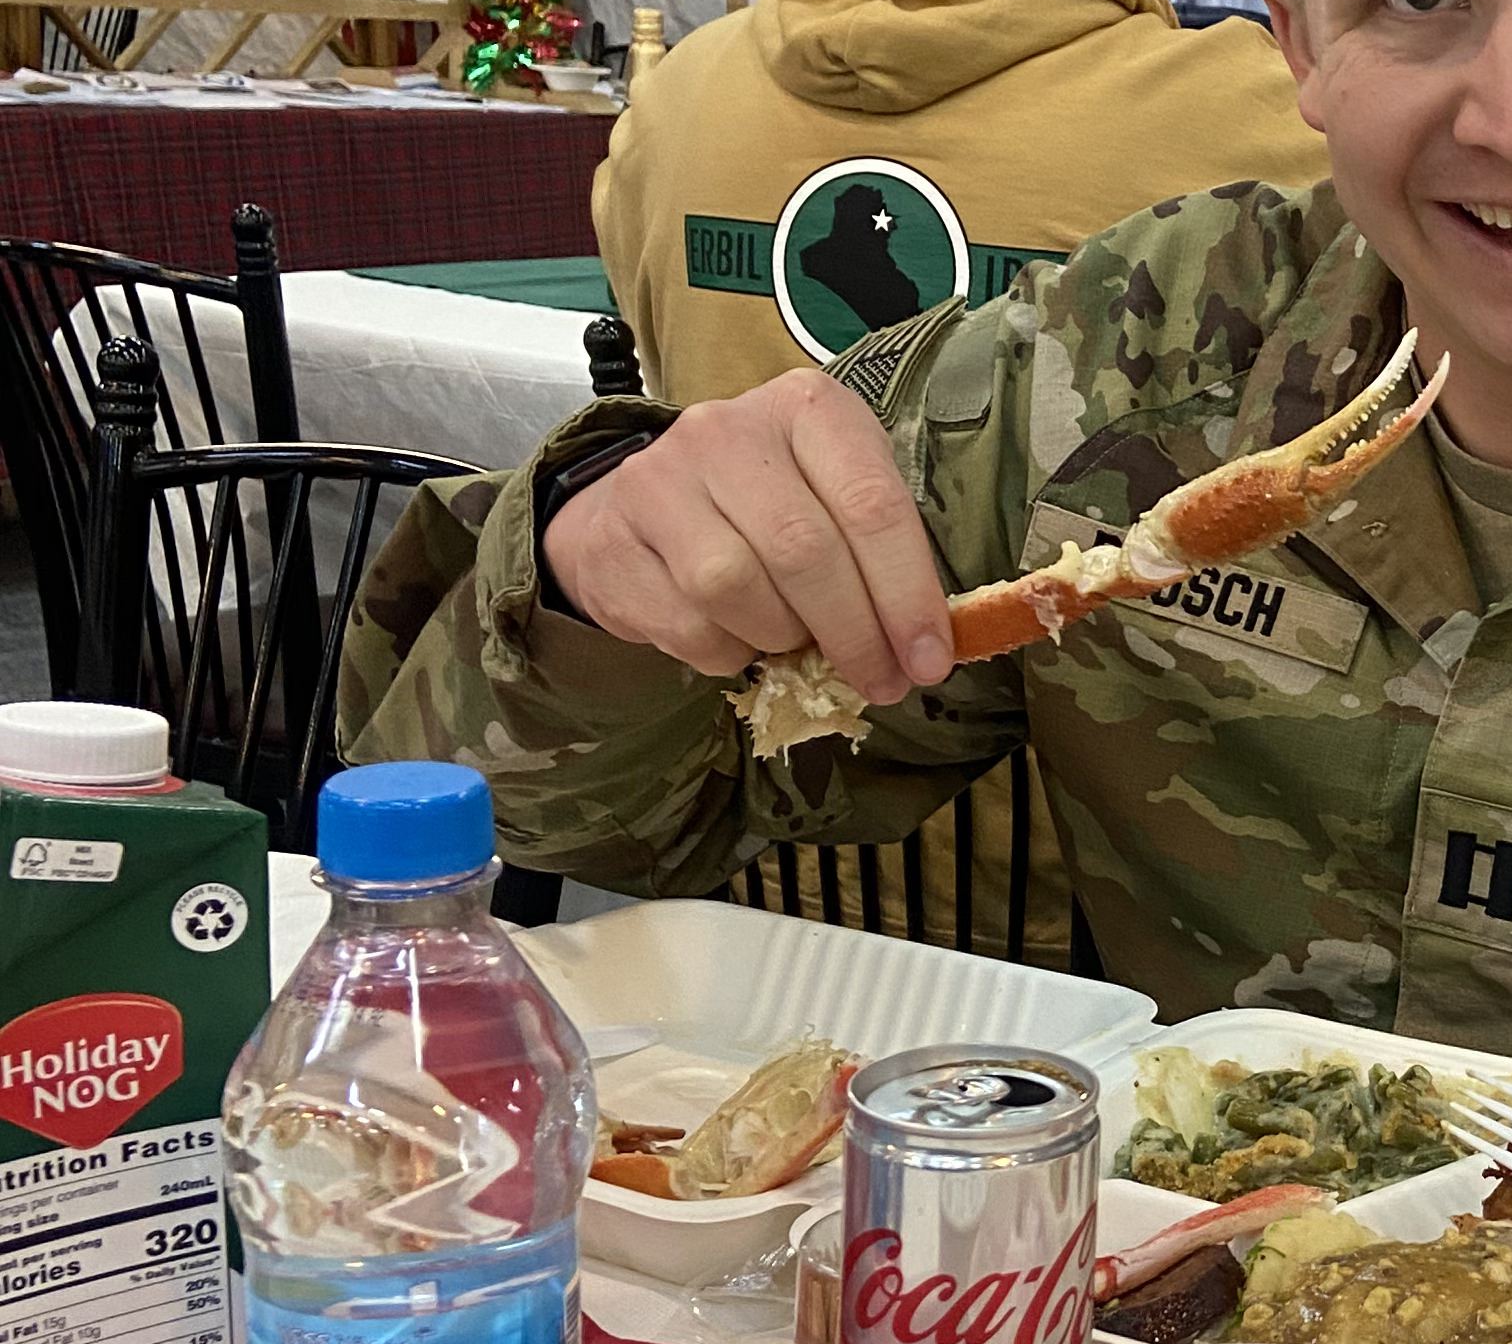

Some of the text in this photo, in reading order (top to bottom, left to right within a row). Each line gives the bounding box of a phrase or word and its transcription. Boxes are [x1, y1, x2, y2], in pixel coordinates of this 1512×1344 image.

[688, 228, 762, 281] ERBIL
[0, 1032, 170, 1089] Holiday
[33, 1067, 140, 1119] NOG
[121, 1131, 215, 1163] Facts
[27, 1212, 60, 1229] size
[161, 1176, 215, 1197] 240mL
[57, 1179, 119, 1203] container
[50, 1238, 103, 1258] serving
[145, 1218, 218, 1258] 320
[145, 1266, 176, 1281] Daily
[13, 1322, 39, 1340] Fat
[185, 1274, 220, 1293] 20%
[187, 1294, 221, 1312] 50%
